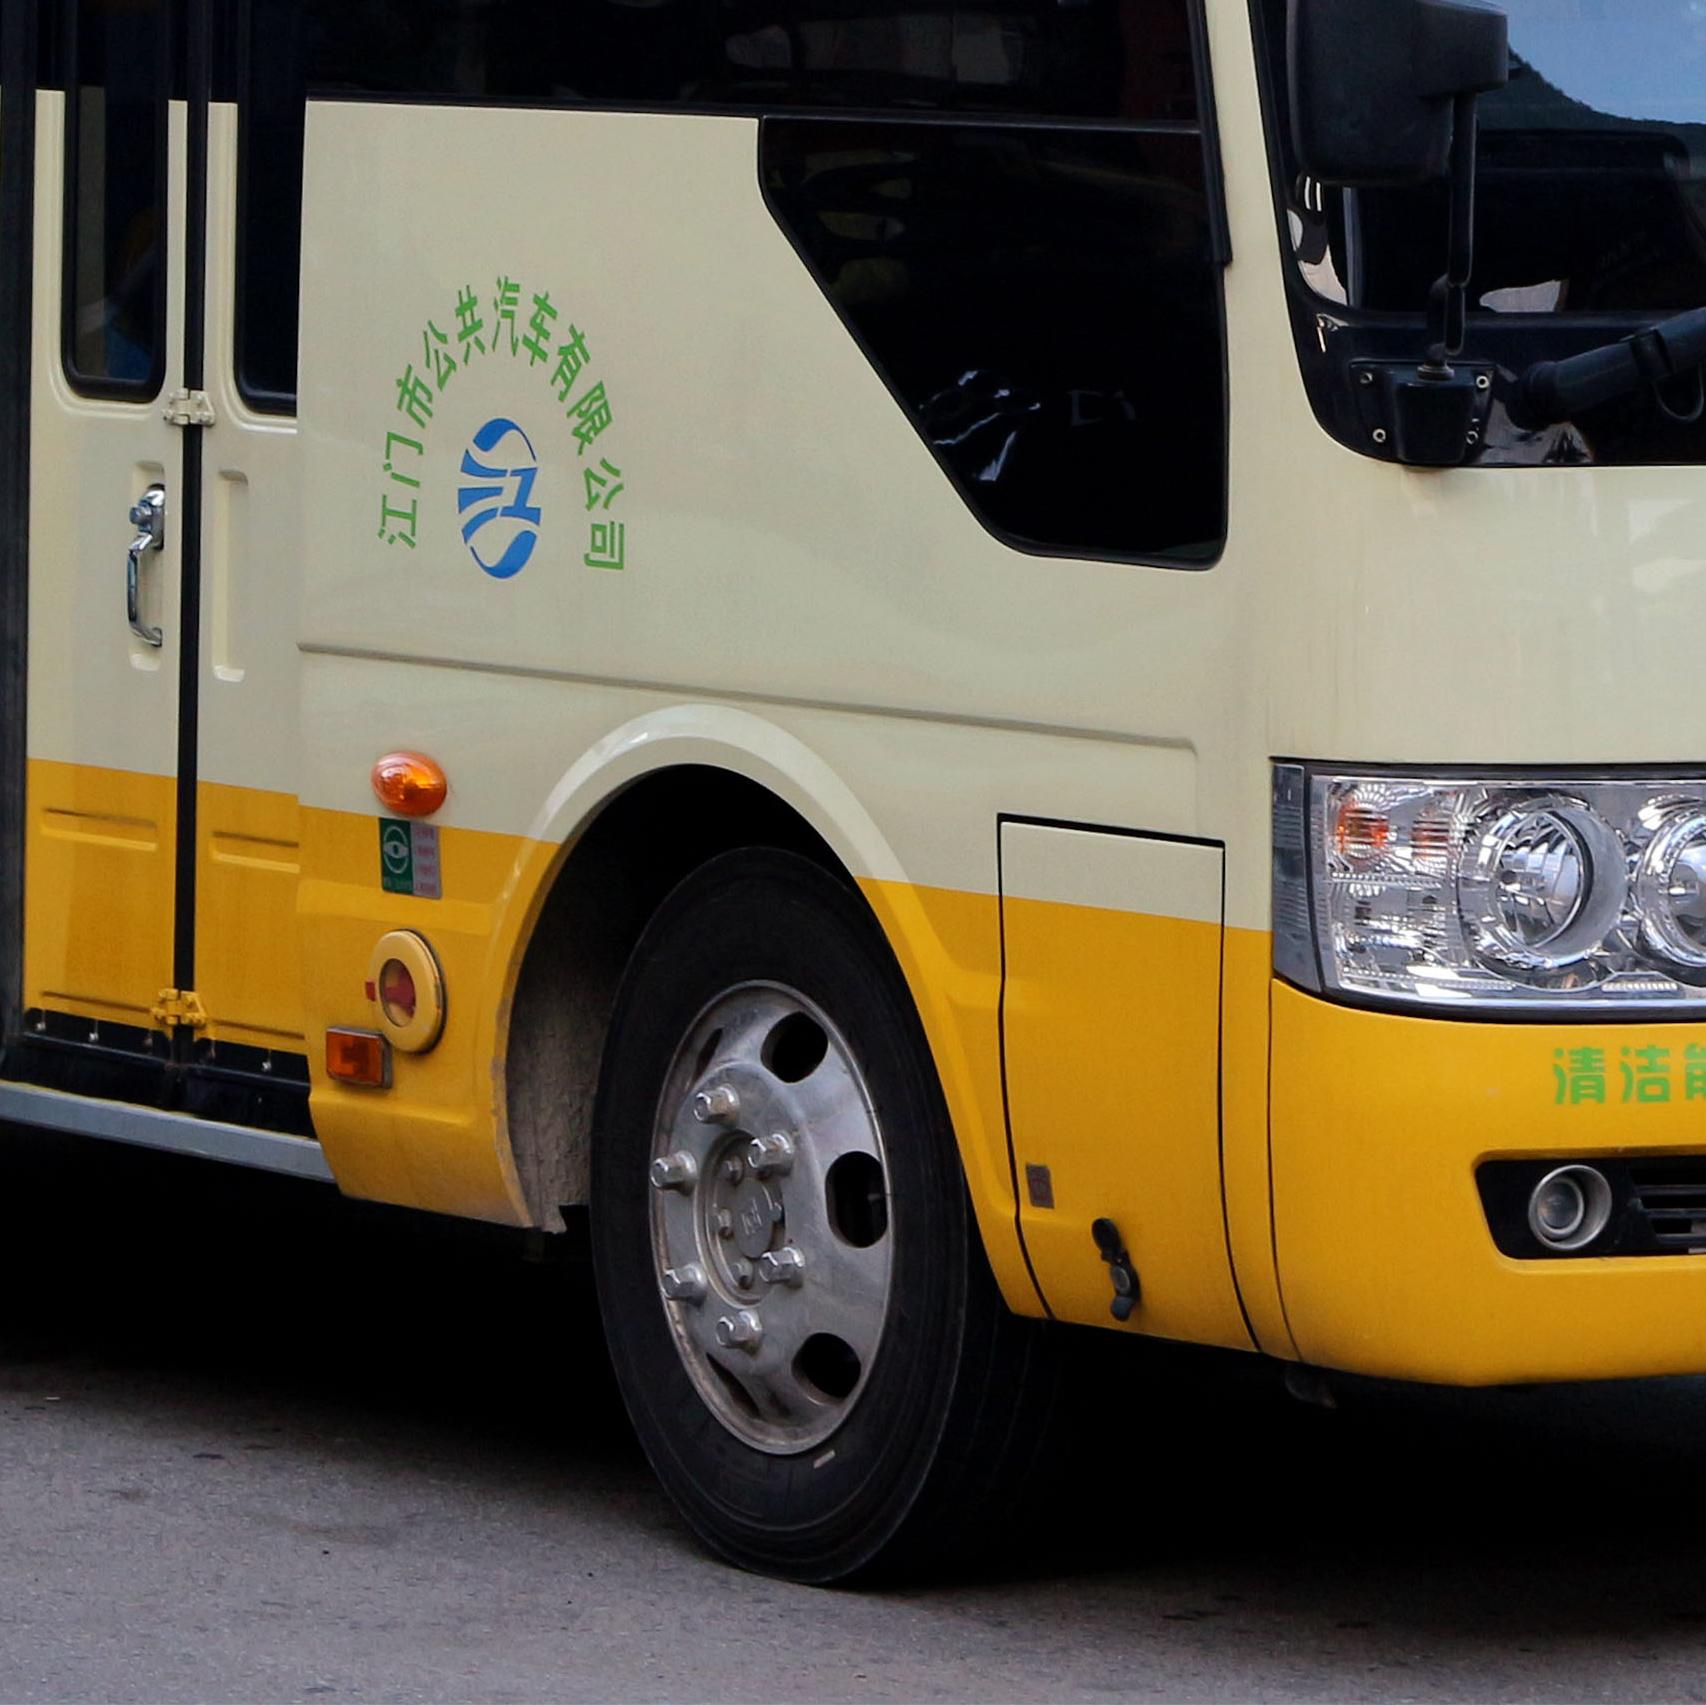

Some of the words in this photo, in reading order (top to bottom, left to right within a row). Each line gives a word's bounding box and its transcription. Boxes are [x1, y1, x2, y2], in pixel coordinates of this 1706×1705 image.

[377, 274, 625, 571] 江门市公共汽车有限公司
